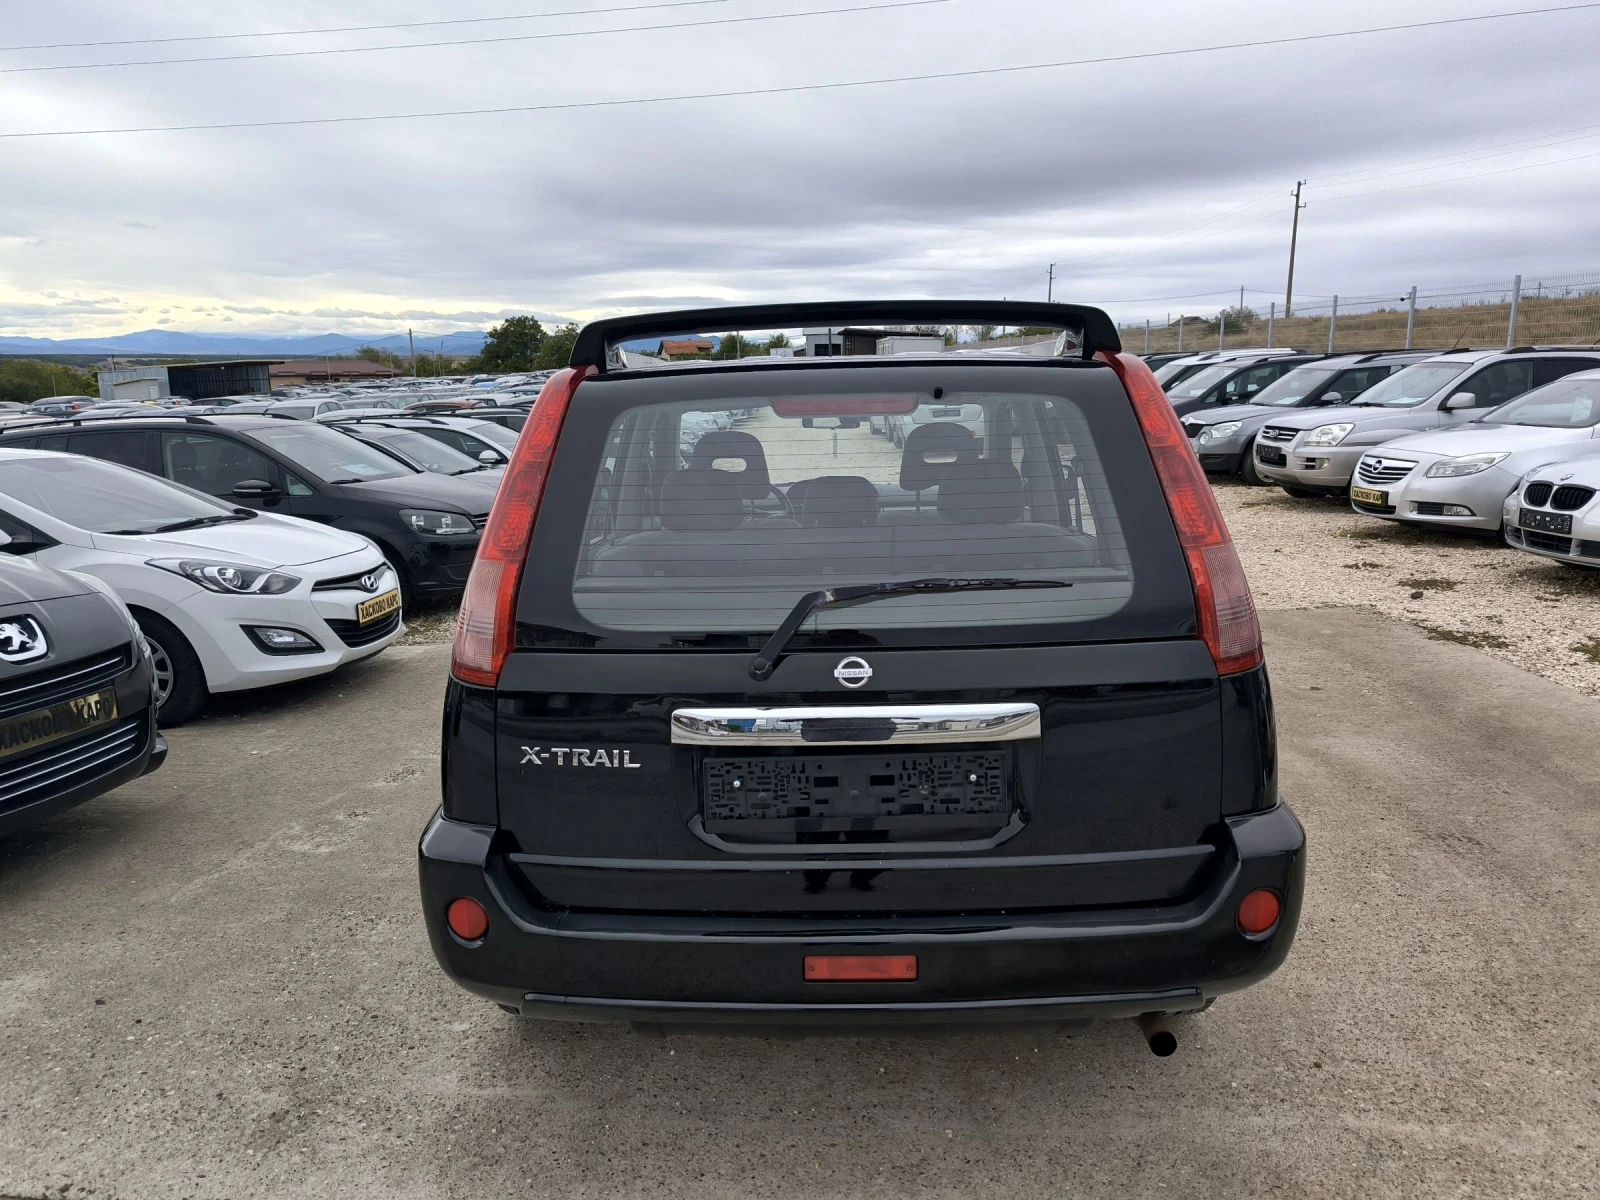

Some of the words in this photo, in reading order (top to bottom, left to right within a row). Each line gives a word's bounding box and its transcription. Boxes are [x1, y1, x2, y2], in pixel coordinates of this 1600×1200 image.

[360, 598, 386, 621] ХАСКОВО
[838, 669, 869, 677] NISSAN
[520, 746, 642, 768] X-TRAIL
